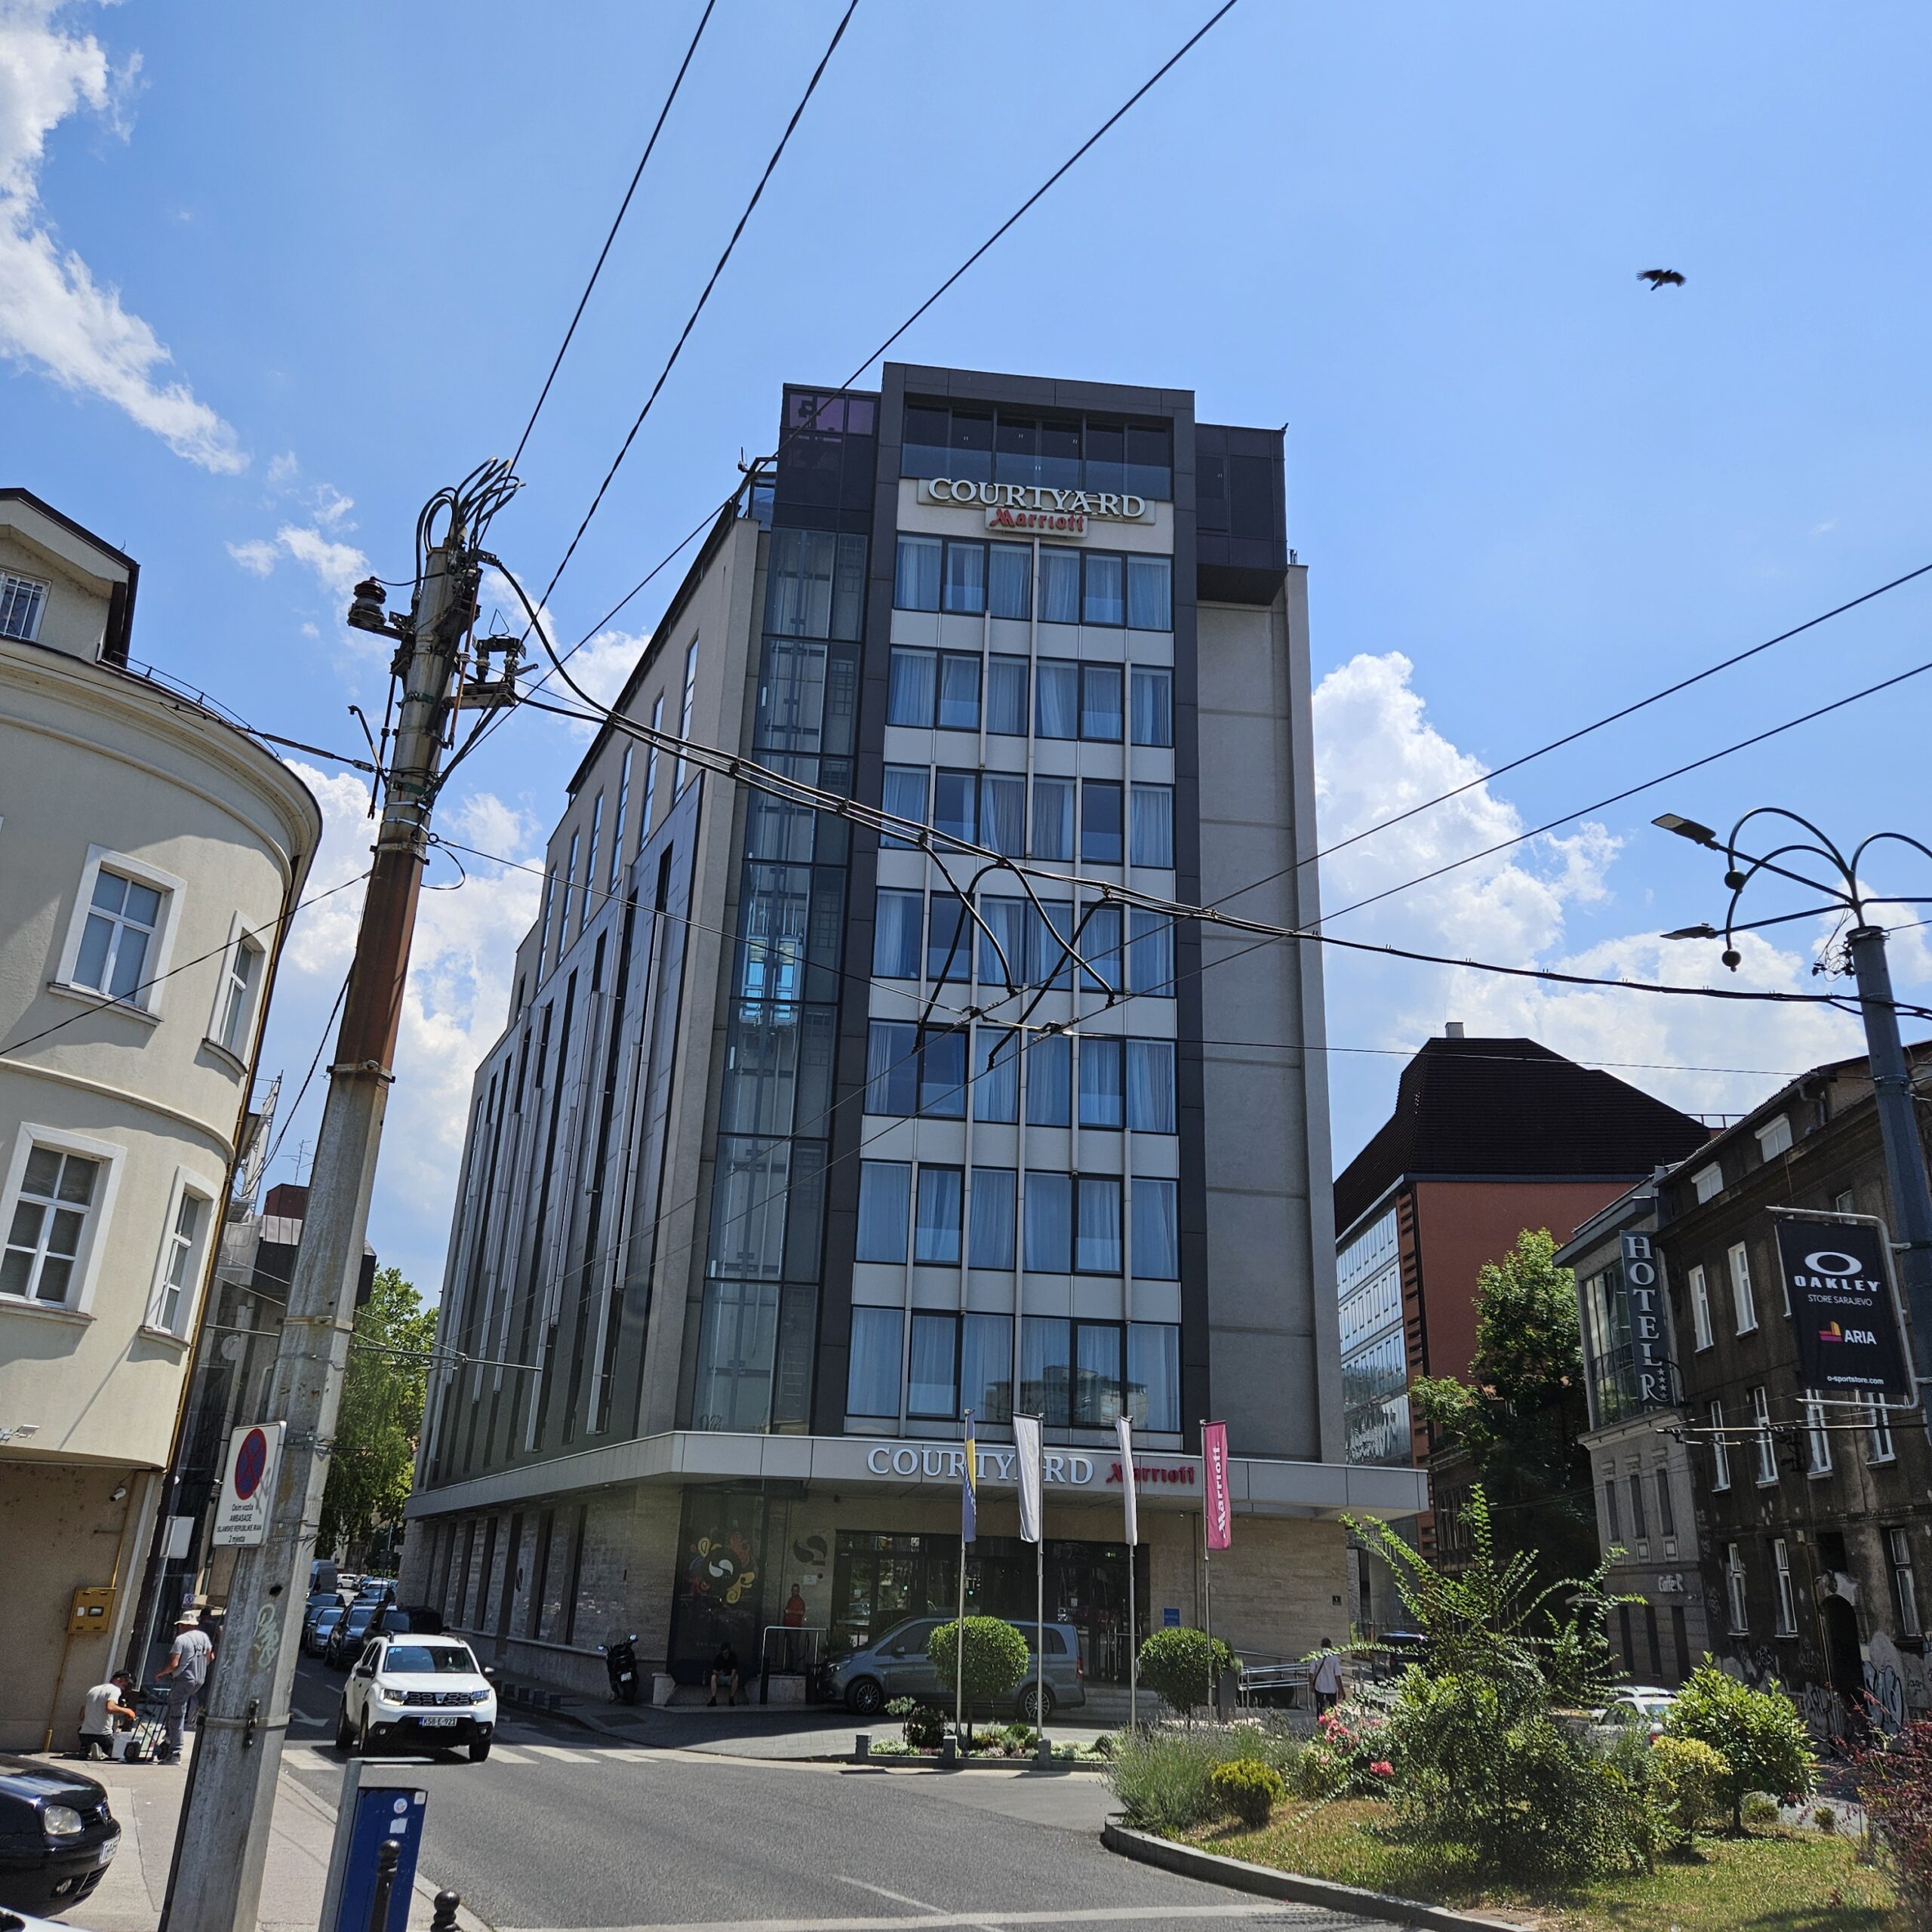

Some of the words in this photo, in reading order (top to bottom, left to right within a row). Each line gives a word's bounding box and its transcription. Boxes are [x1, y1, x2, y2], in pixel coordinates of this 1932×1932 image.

[928, 478, 1146, 517] COURTYARD
[989, 508, 1084, 532] Marriott
[1794, 1275, 1880, 1292] OAKLEY
[1625, 1236, 1663, 1367] HOTEL
[1807, 1294, 1833, 1303] STORE
[1834, 1297, 1872, 1306] SARAJEVO
[1844, 1330, 1877, 1345] ARIA
[1827, 1375, 1884, 1385] o-sportstore.com
[867, 1447, 1094, 1484] COURTYRD
[1212, 1446, 1226, 1540] Marriott
